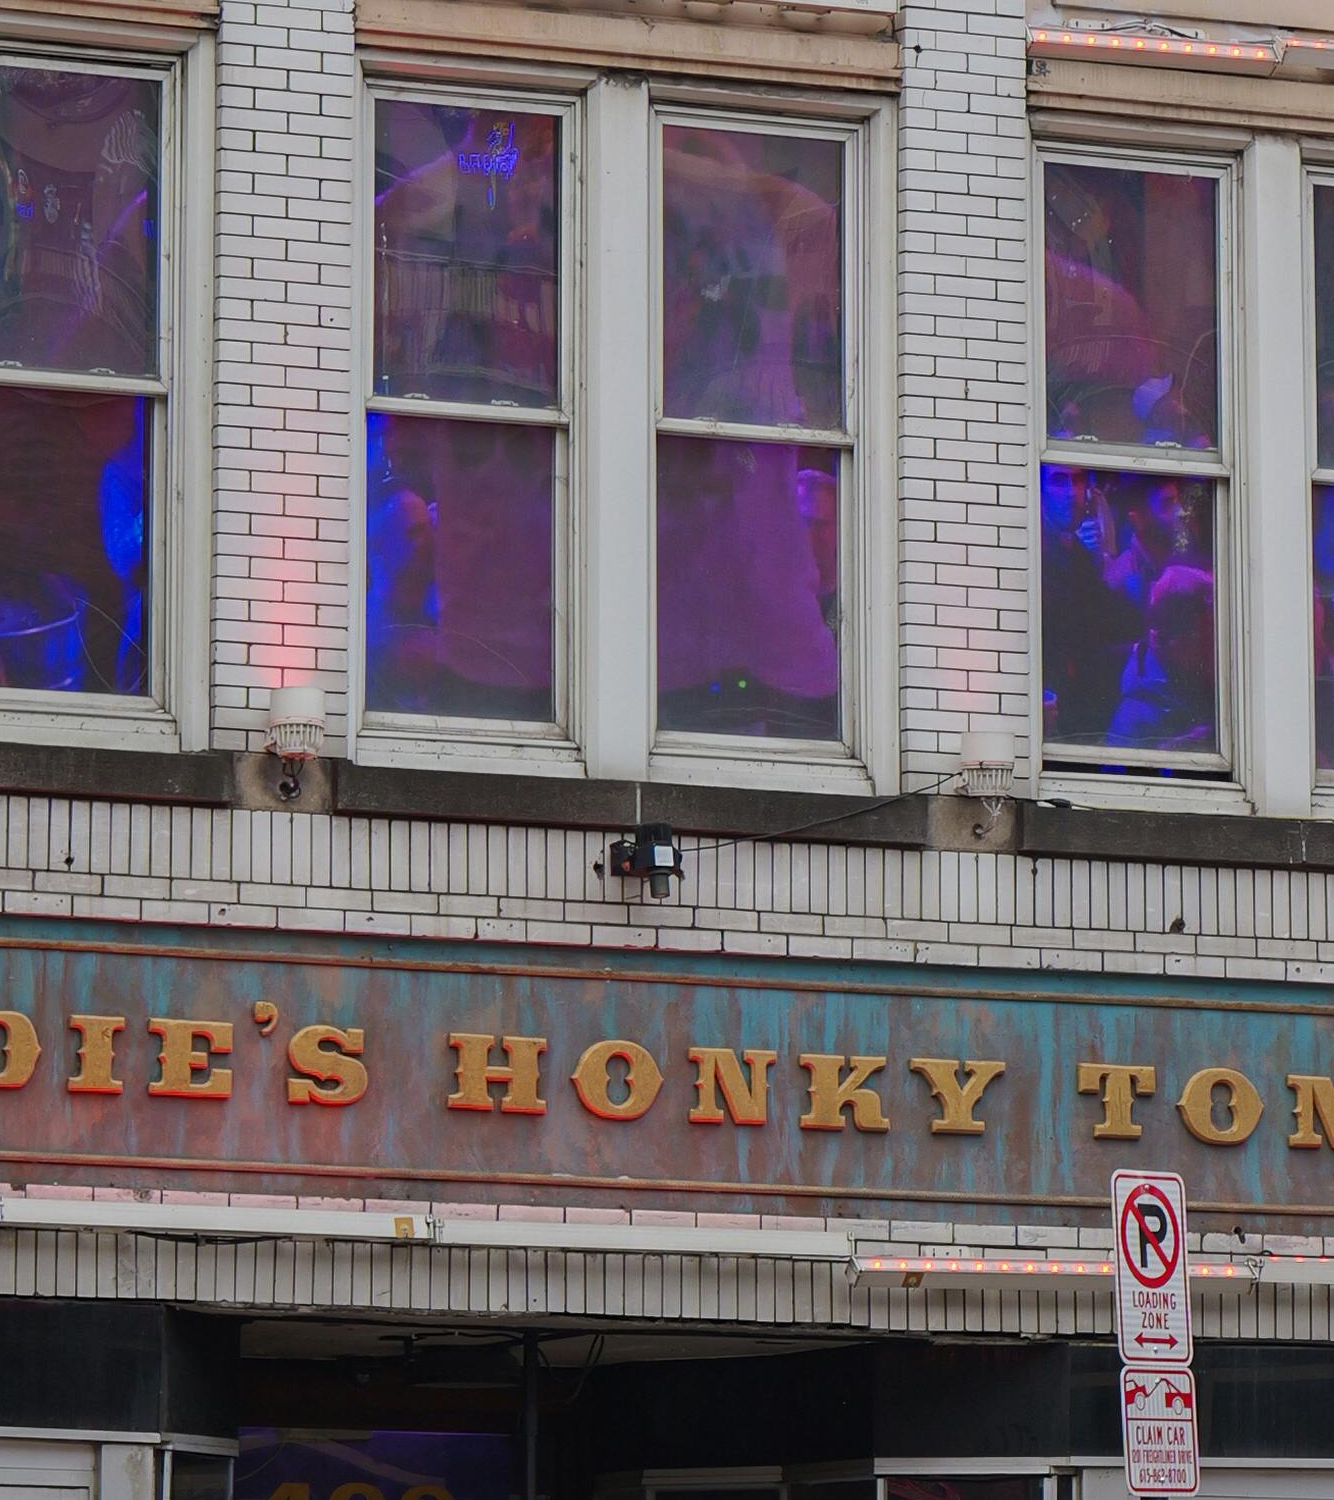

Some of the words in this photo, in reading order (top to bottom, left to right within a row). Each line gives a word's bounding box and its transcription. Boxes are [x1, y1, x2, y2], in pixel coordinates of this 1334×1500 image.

[446, 1032, 1006, 1135] HONKY
[1132, 1291, 1177, 1311] LOADING
[1141, 1312, 1170, 1330] ZONE
[1136, 1425, 1164, 1446] CLAIM
[1167, 1425, 1186, 1446] CAR
